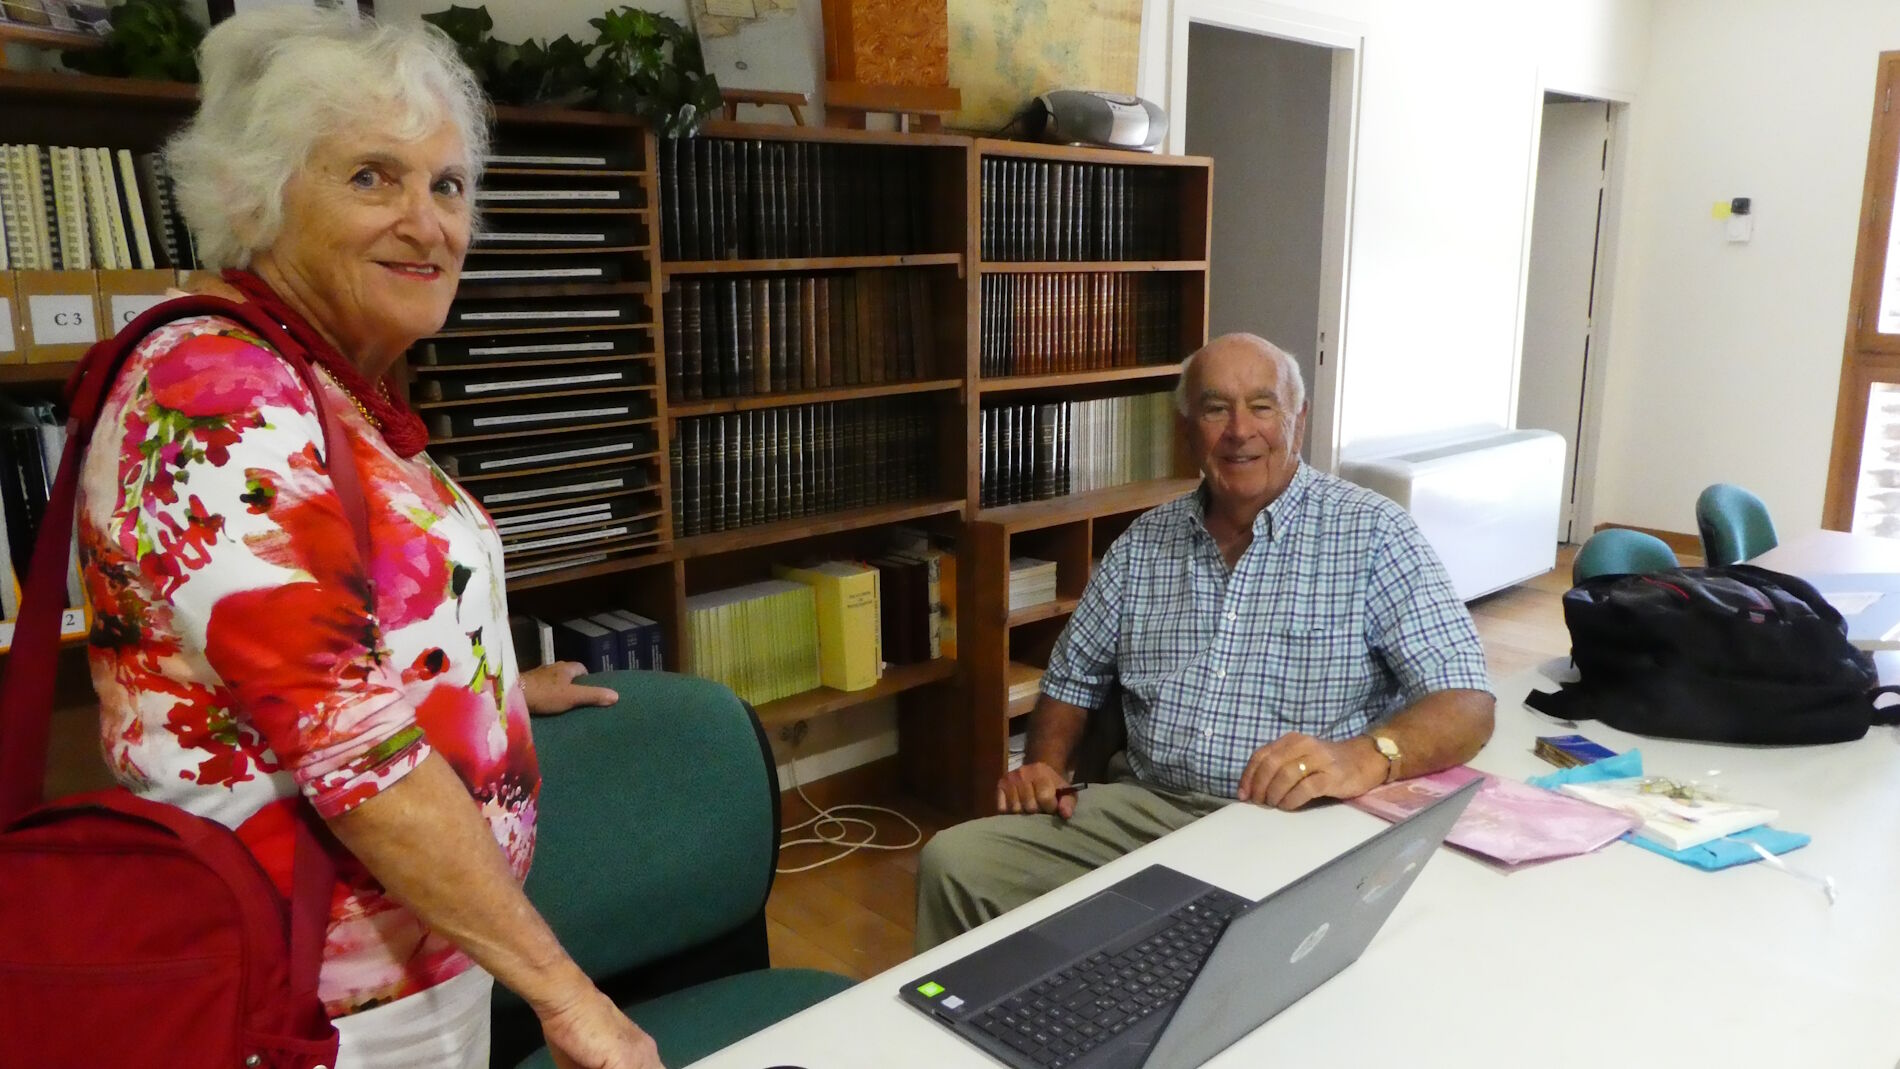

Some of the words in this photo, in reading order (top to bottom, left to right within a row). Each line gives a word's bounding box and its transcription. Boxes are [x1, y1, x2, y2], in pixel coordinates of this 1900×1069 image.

[54, 313, 68, 326] C
[73, 312, 82, 326] 3
[65, 613, 76, 626] 2
